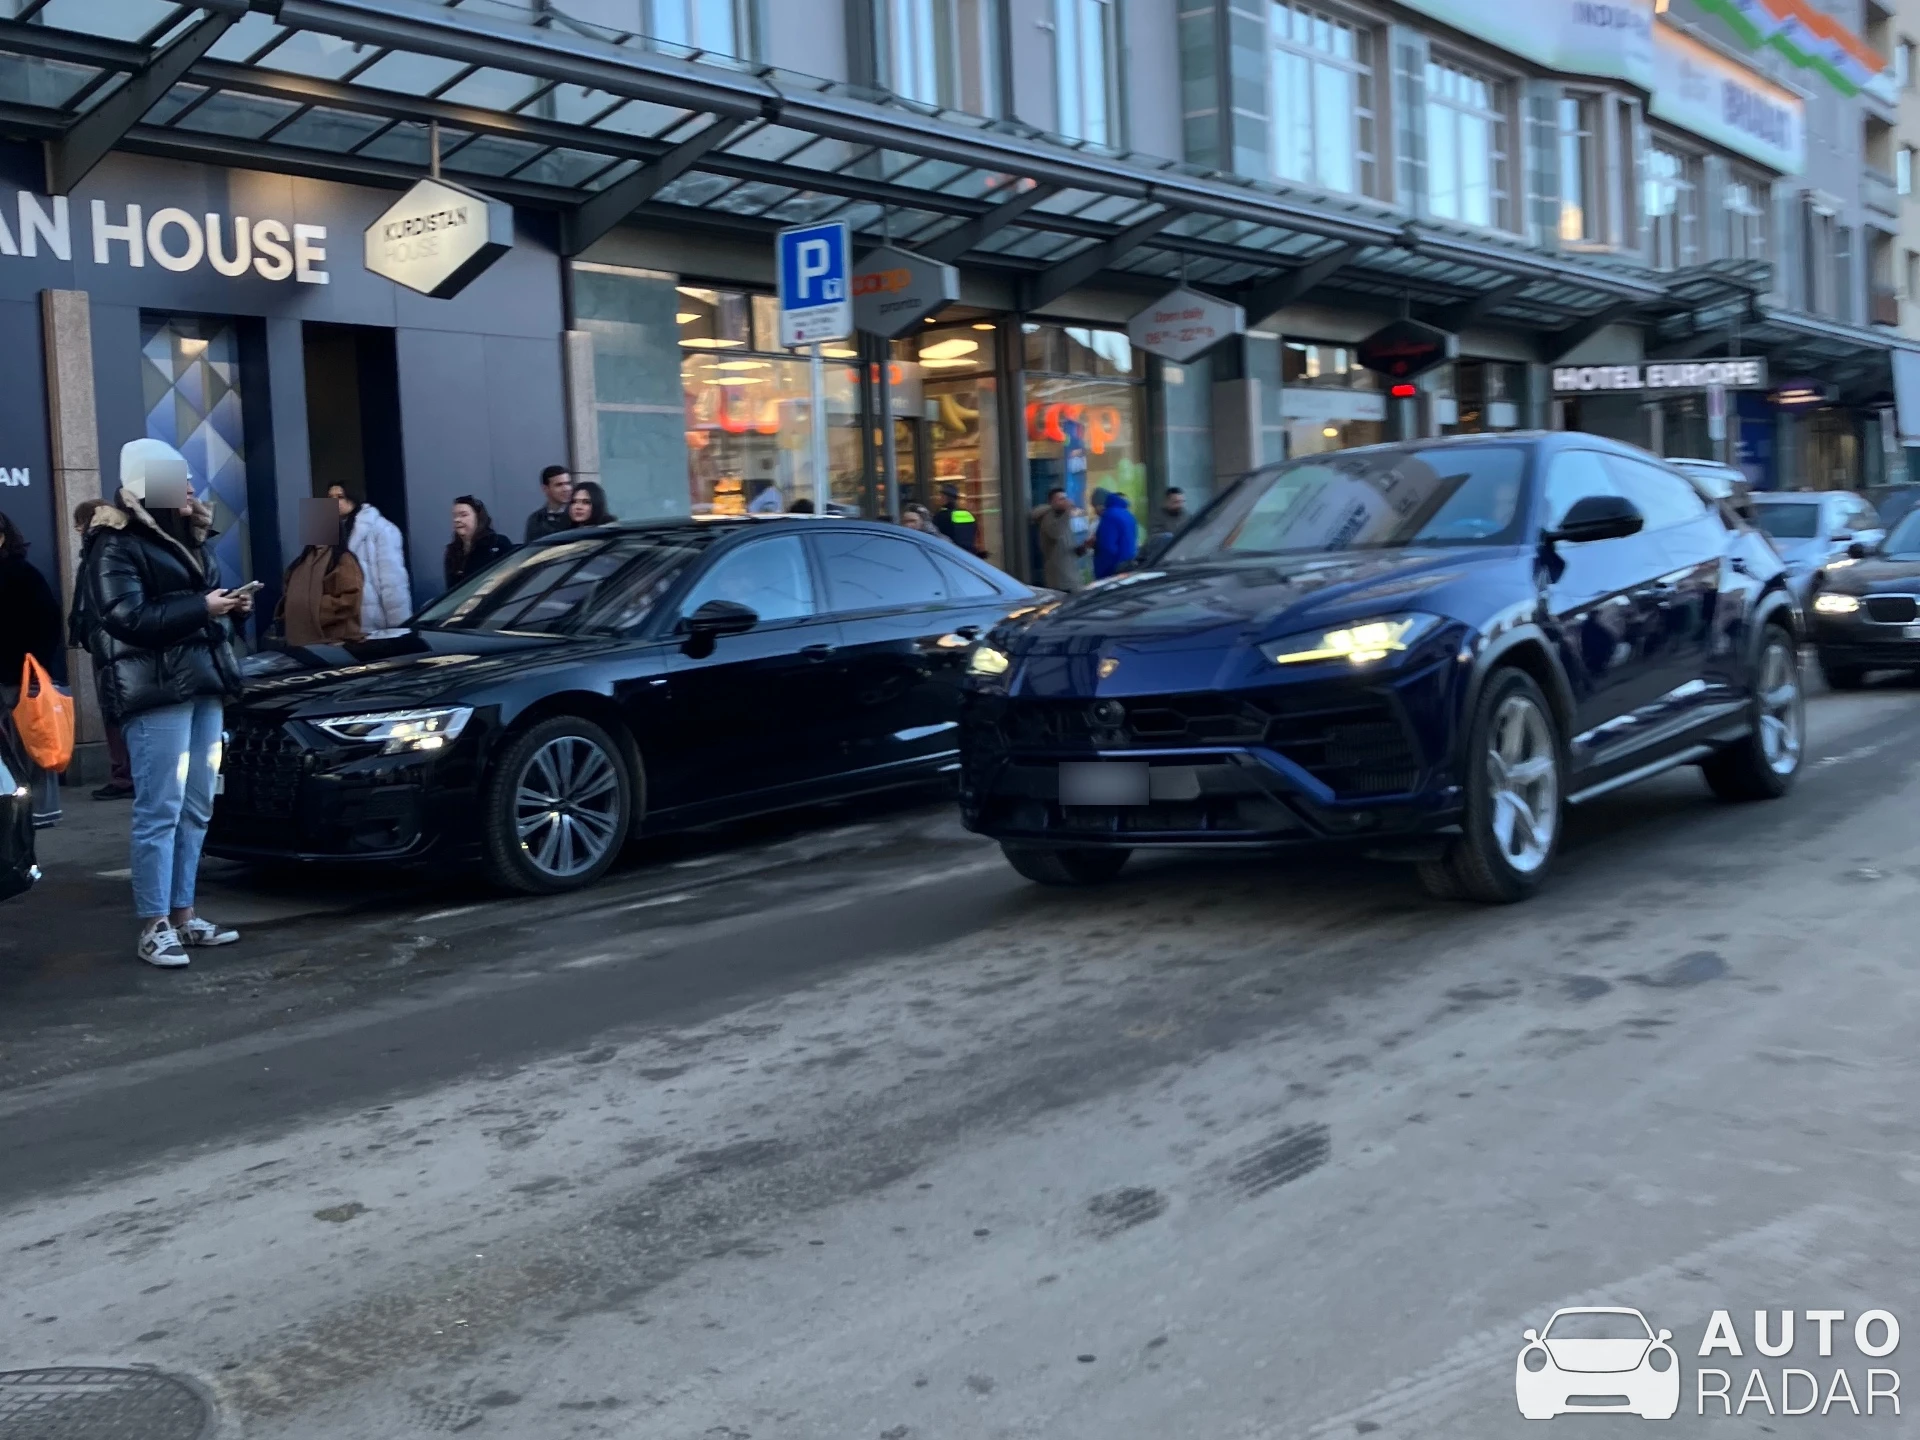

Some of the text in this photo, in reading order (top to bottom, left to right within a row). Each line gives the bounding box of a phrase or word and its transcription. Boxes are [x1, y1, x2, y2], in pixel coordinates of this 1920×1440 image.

[90, 199, 330, 285] HOUSE
[383, 206, 469, 243] KURDISTAN
[796, 238, 831, 299] P
[880, 298, 922, 315] pronto
[1553, 361, 1761, 391] HOTEL EUROPE
